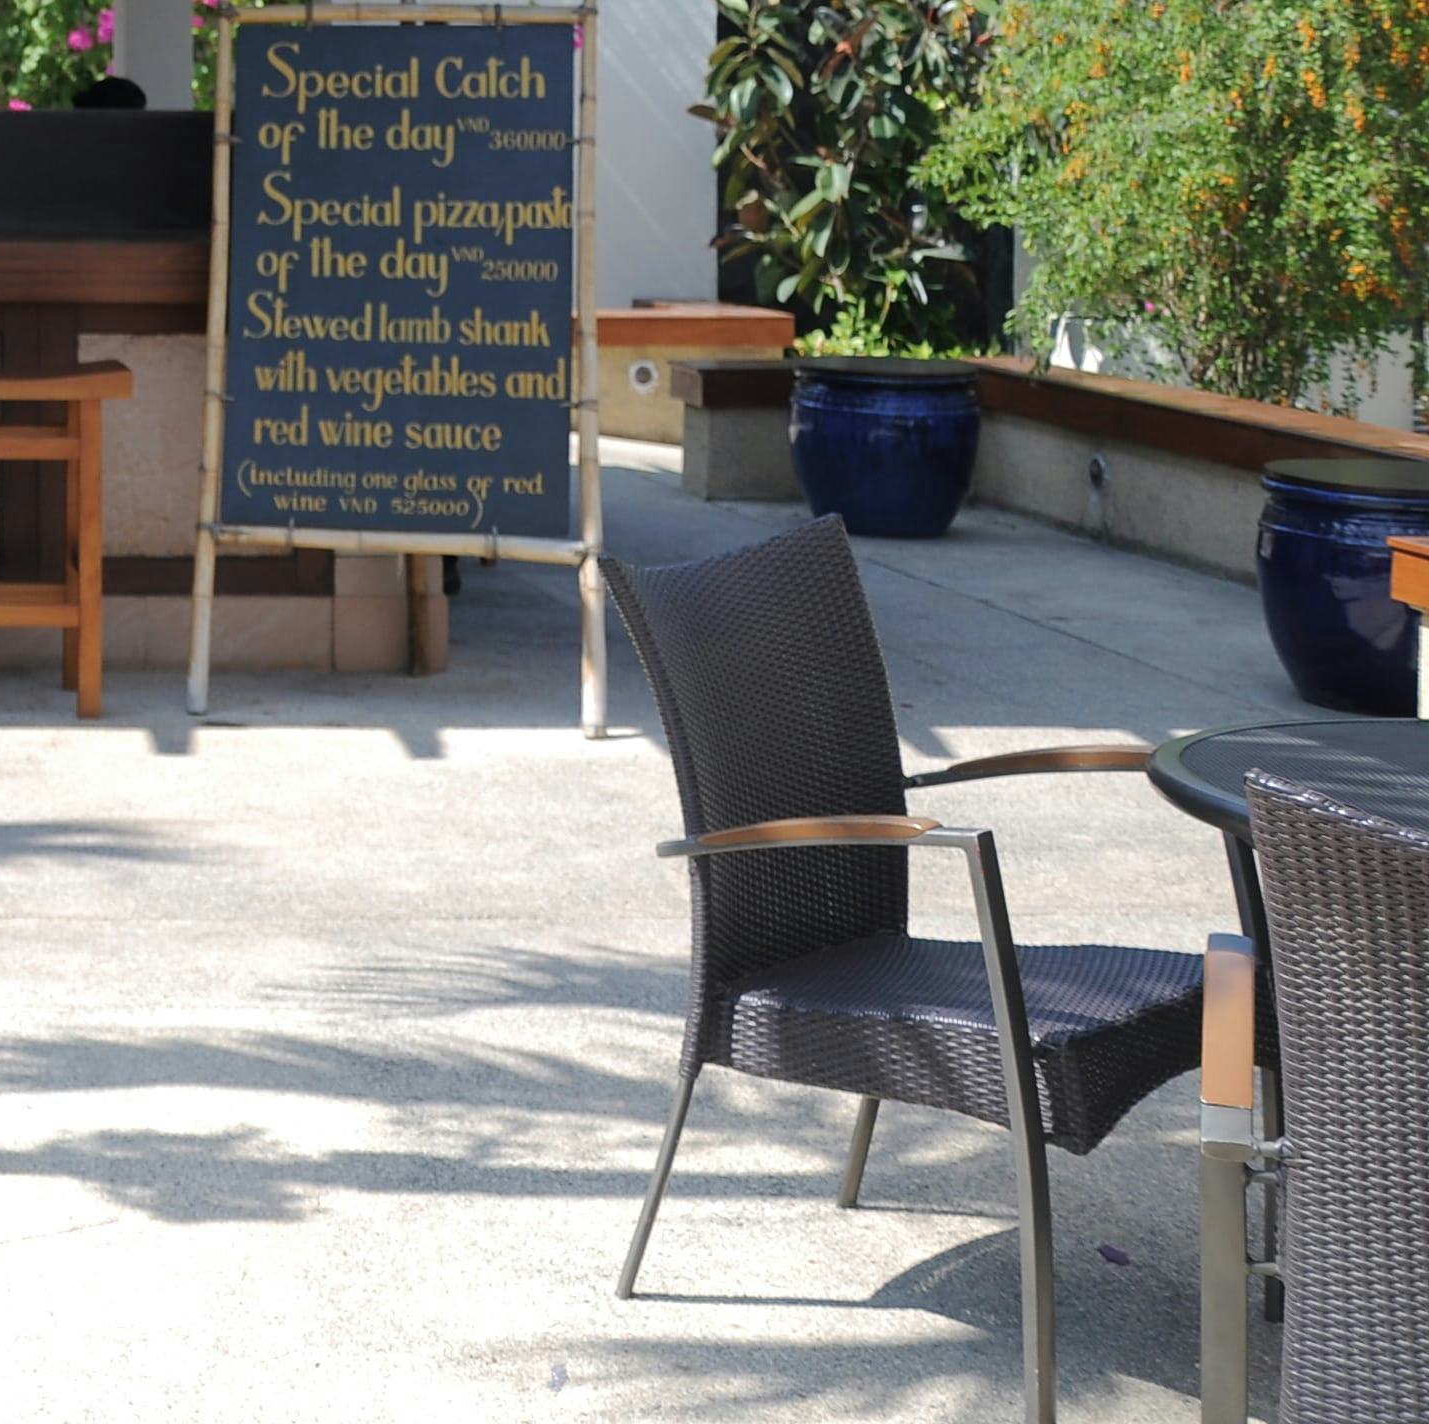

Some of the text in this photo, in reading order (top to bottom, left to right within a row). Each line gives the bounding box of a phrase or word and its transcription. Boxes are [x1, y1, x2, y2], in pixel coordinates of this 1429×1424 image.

[261, 40, 546, 115] Special Catch
[257, 107, 566, 168] of the day VND 360000
[256, 171, 401, 243] Special
[256, 236, 559, 296] of the day VND 250000
[242, 289, 551, 348] Stewed lamb shank
[254, 349, 566, 412] with vegetables and
[253, 403, 503, 451] red wine sauce
[273, 490, 327, 513] wine
[339, 496, 378, 514] VND
[360, 474, 398, 490] one
[403, 469, 458, 498] glass
[466, 476, 494, 501] of
[502, 472, 545, 495] red
